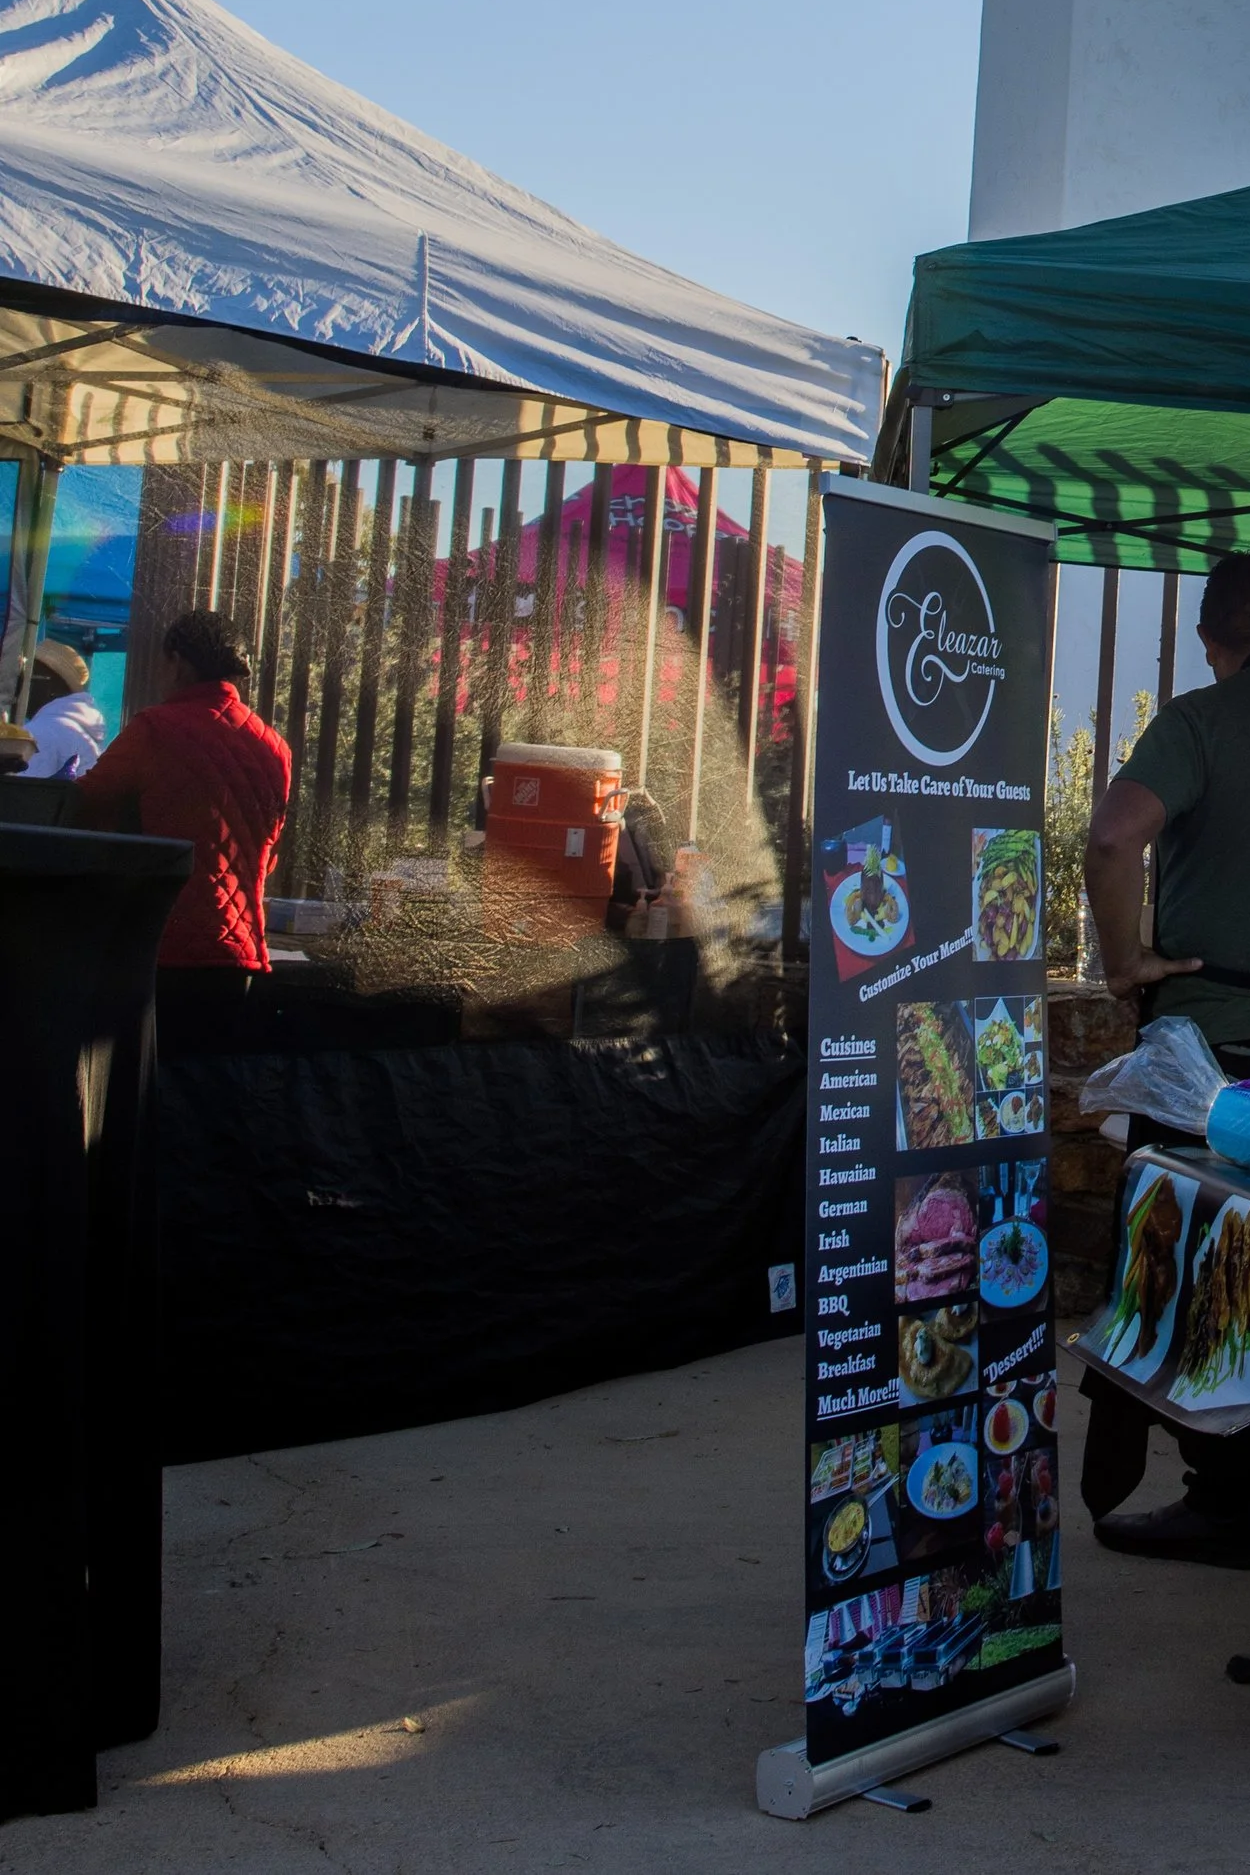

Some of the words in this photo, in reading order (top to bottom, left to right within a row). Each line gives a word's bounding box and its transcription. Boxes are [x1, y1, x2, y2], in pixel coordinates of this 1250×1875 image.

[887, 591, 1002, 707] Eleazar
[970, 661, 1006, 681] Catering
[848, 770, 870, 792] Let
[871, 771, 888, 793] Us
[888, 773, 919, 795] Take
[920, 775, 950, 797] Care
[951, 776, 966, 797] of
[965, 778, 995, 799] Your
[996, 781, 1031, 802] Guests
[858, 964, 912, 1003] Customize
[910, 950, 940, 974] Your
[939, 926, 975, 962] Menu!!!
[820, 1036, 877, 1057] Cuisines
[819, 1070, 878, 1090] American
[819, 1102, 871, 1122] Mexican
[819, 1133, 861, 1154] Italian
[819, 1164, 876, 1186] Hawaiian
[818, 1198, 868, 1218] German
[818, 1229, 851, 1251] Irish
[818, 1256, 888, 1286] Argentinian
[818, 1294, 850, 1316] BBQ
[818, 1321, 882, 1350] Vegetarian
[817, 1354, 876, 1380] Breakfast
[817, 1386, 856, 1415] Much
[857, 1378, 900, 1405] More!!!
